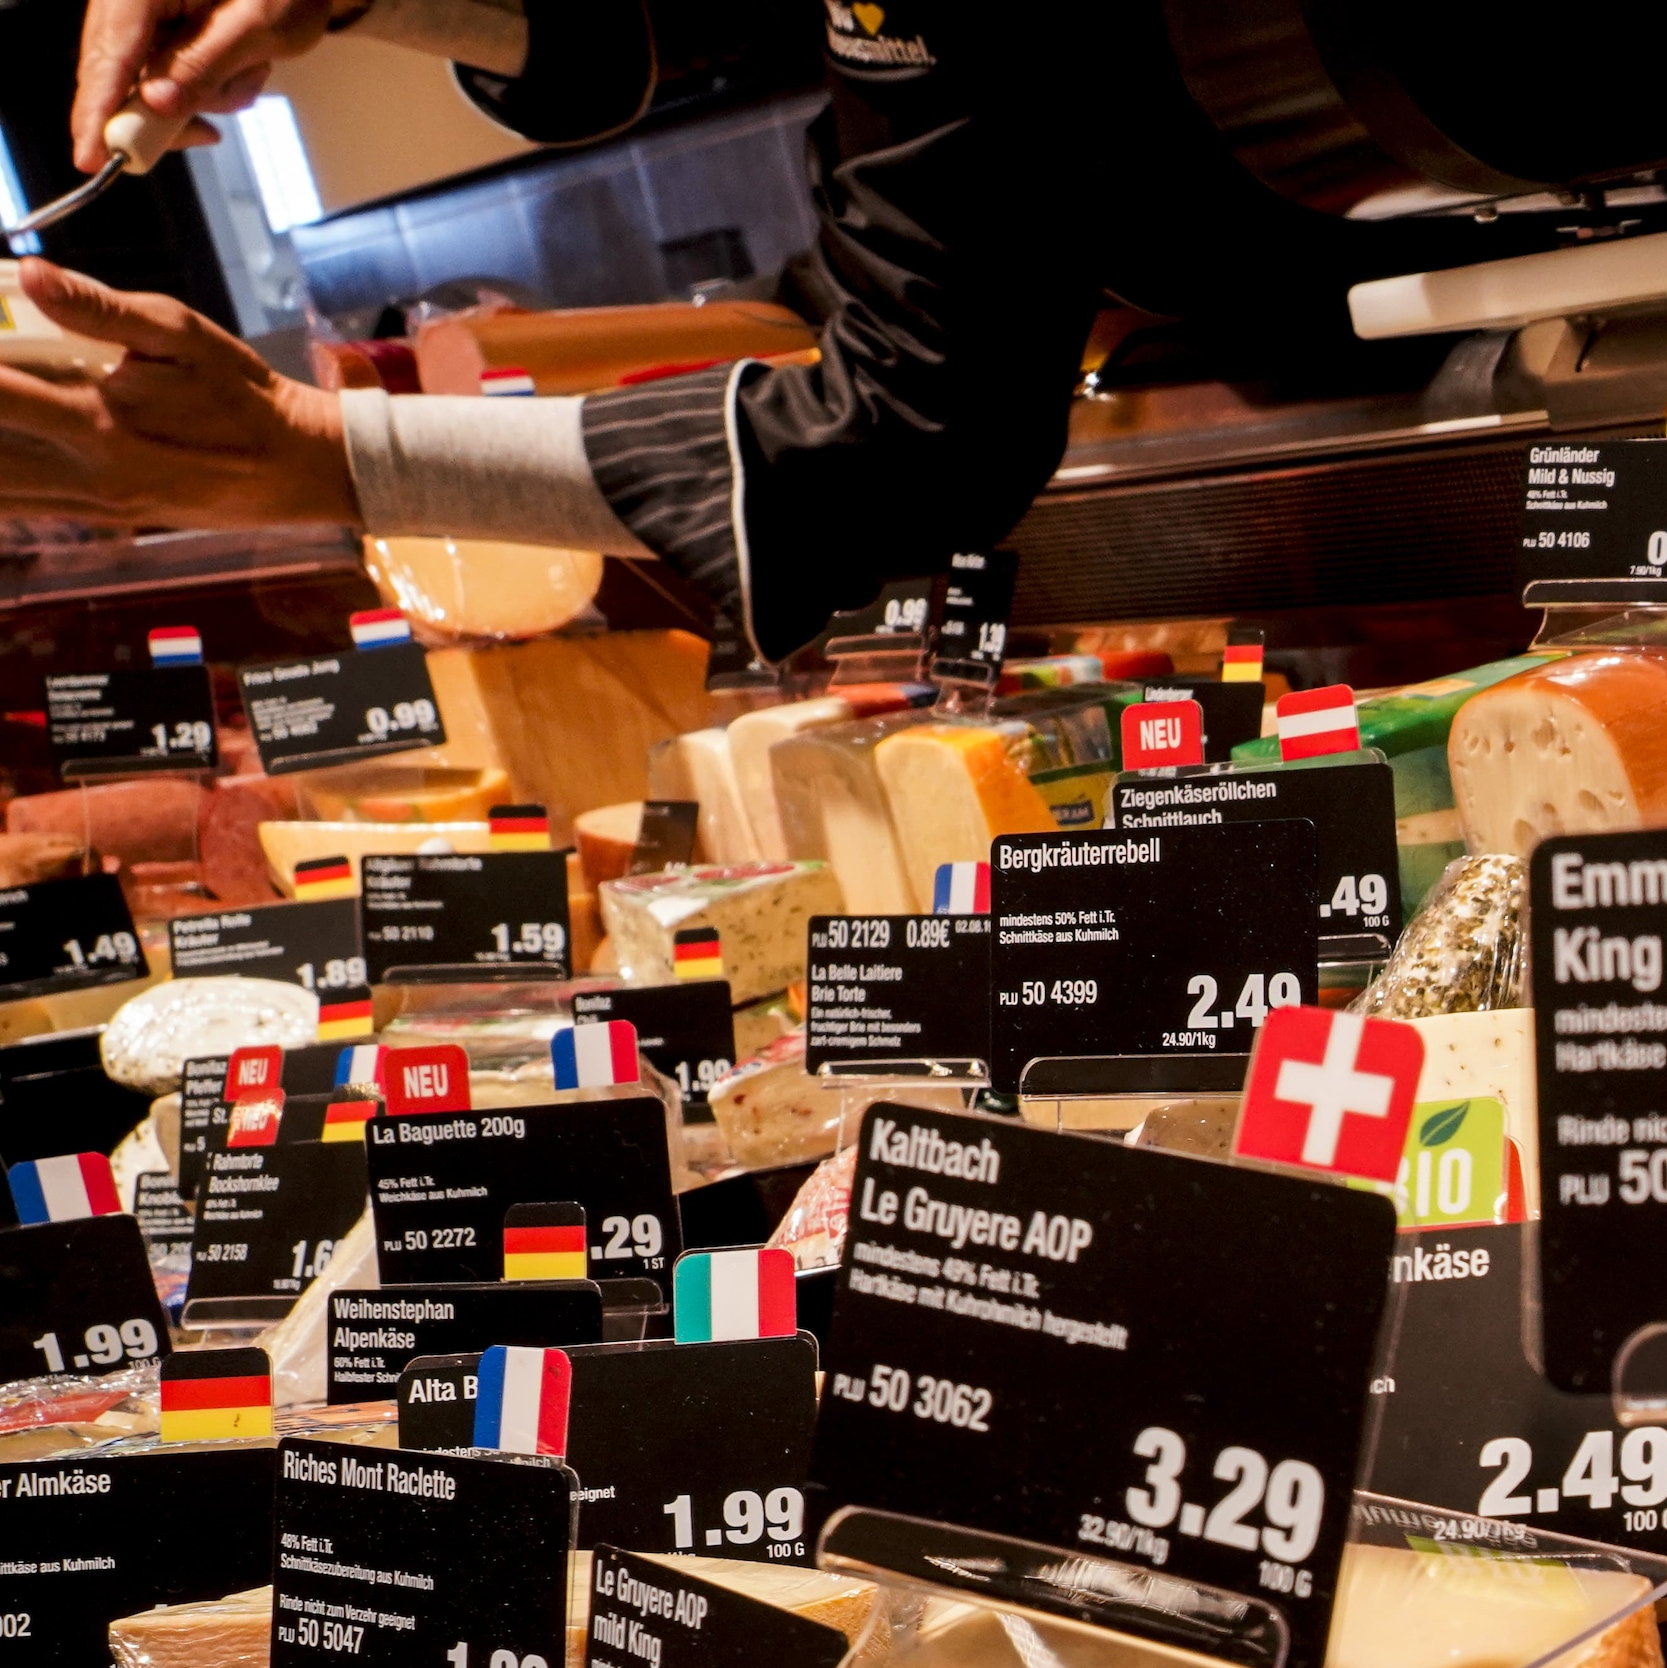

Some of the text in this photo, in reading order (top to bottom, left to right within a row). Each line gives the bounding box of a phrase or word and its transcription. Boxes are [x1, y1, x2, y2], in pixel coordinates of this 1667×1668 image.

[1528, 445, 1600, 464] Grünländer
[1527, 466, 1616, 488] Mild & Nussig
[1521, 530, 1591, 548] PLU 50 4106
[366, 698, 436, 734] 0.99
[150, 720, 211, 750] 1.29
[1140, 718, 1181, 751] NEU
[1119, 779, 1277, 810] Ziegenkäseröllchen
[1121, 807, 1223, 829] Schnittlauch
[998, 836, 1160, 873] Bergkräuterrebell
[65, 931, 136, 966] 1.49
[490, 923, 566, 953] 1.59
[811, 918, 950, 948] PLU 50 2129 0.89€
[810, 963, 903, 981] La Belle Laitiere
[1552, 925, 1662, 992] King
[810, 983, 866, 1003] Brie Torte
[998, 978, 1098, 1006] PLU 50 4399
[1186, 971, 1302, 1029] 2.49
[238, 1057, 269, 1086] NEU
[403, 1063, 449, 1099] NEU
[371, 1114, 526, 1145] La Baguette 200g
[868, 1117, 1000, 1184] Kaltbach
[1558, 1173, 1610, 1205] PLU
[859, 1176, 1093, 1263] Le Gruyere AOP
[382, 1226, 477, 1252] PLU 50 2272
[332, 1296, 455, 1324] Weihenstephan
[34, 1318, 158, 1372] 1.99
[332, 1325, 416, 1352] Alpenkäse
[407, 1377, 457, 1404] Alta
[14, 1468, 111, 1498] Almkäse
[282, 1448, 337, 1485] Riches
[340, 1456, 384, 1491] Mont
[385, 1461, 456, 1501] Raclette
[1124, 1425, 1325, 1563] 3.29
[662, 1486, 804, 1548] 1.99
[594, 1558, 708, 1630] Le Gruyere AOP
[277, 1616, 365, 1654] PLU 50 5047
[592, 1610, 627, 1650] mild
